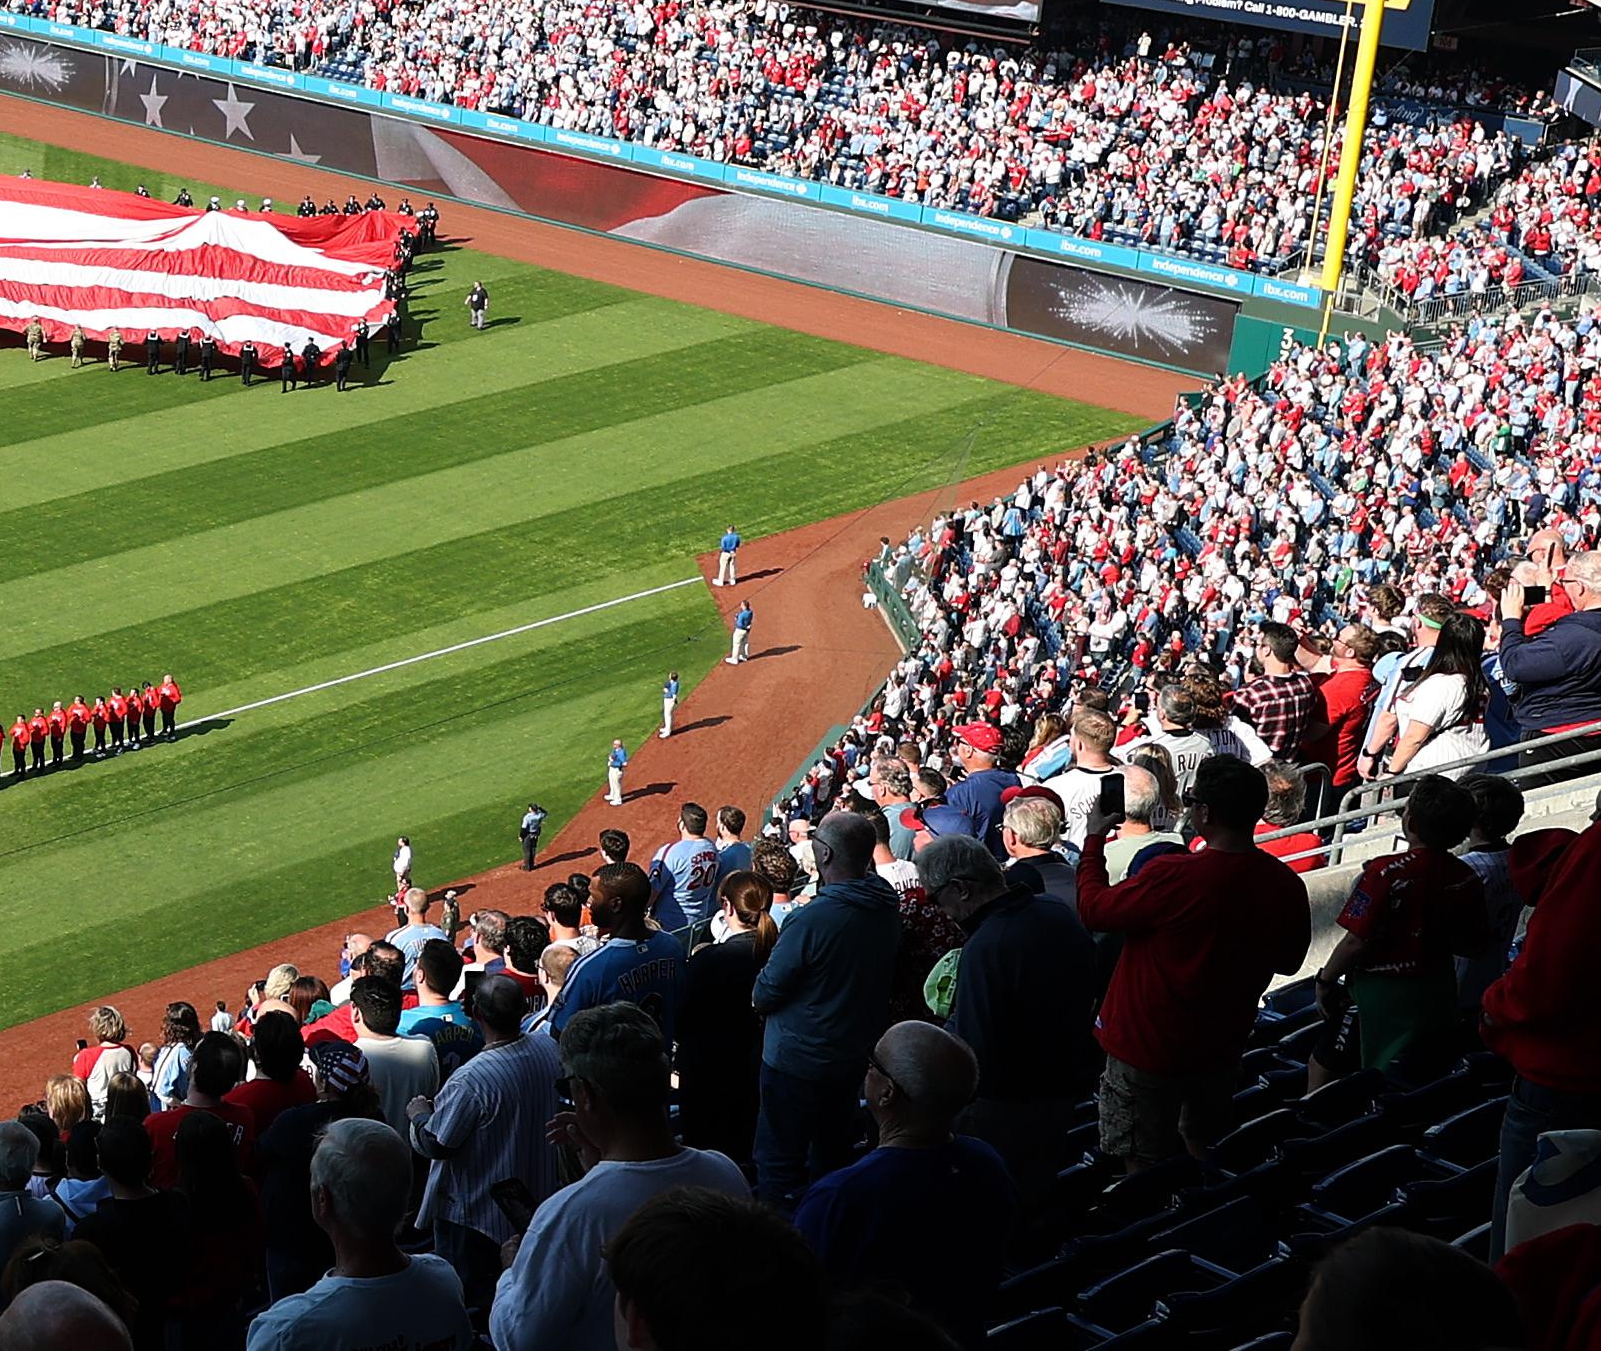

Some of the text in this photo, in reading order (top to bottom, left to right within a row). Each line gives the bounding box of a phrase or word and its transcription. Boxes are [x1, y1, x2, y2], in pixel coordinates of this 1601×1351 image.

[1243, 1, 1265, 14] Call
[557, 132, 621, 154] Independence
[736, 171, 796, 194] Independence
[935, 211, 1000, 237] Independence
[1152, 258, 1224, 285] Independence
[687, 864, 717, 891] 20
[619, 958, 677, 993] HARPER
